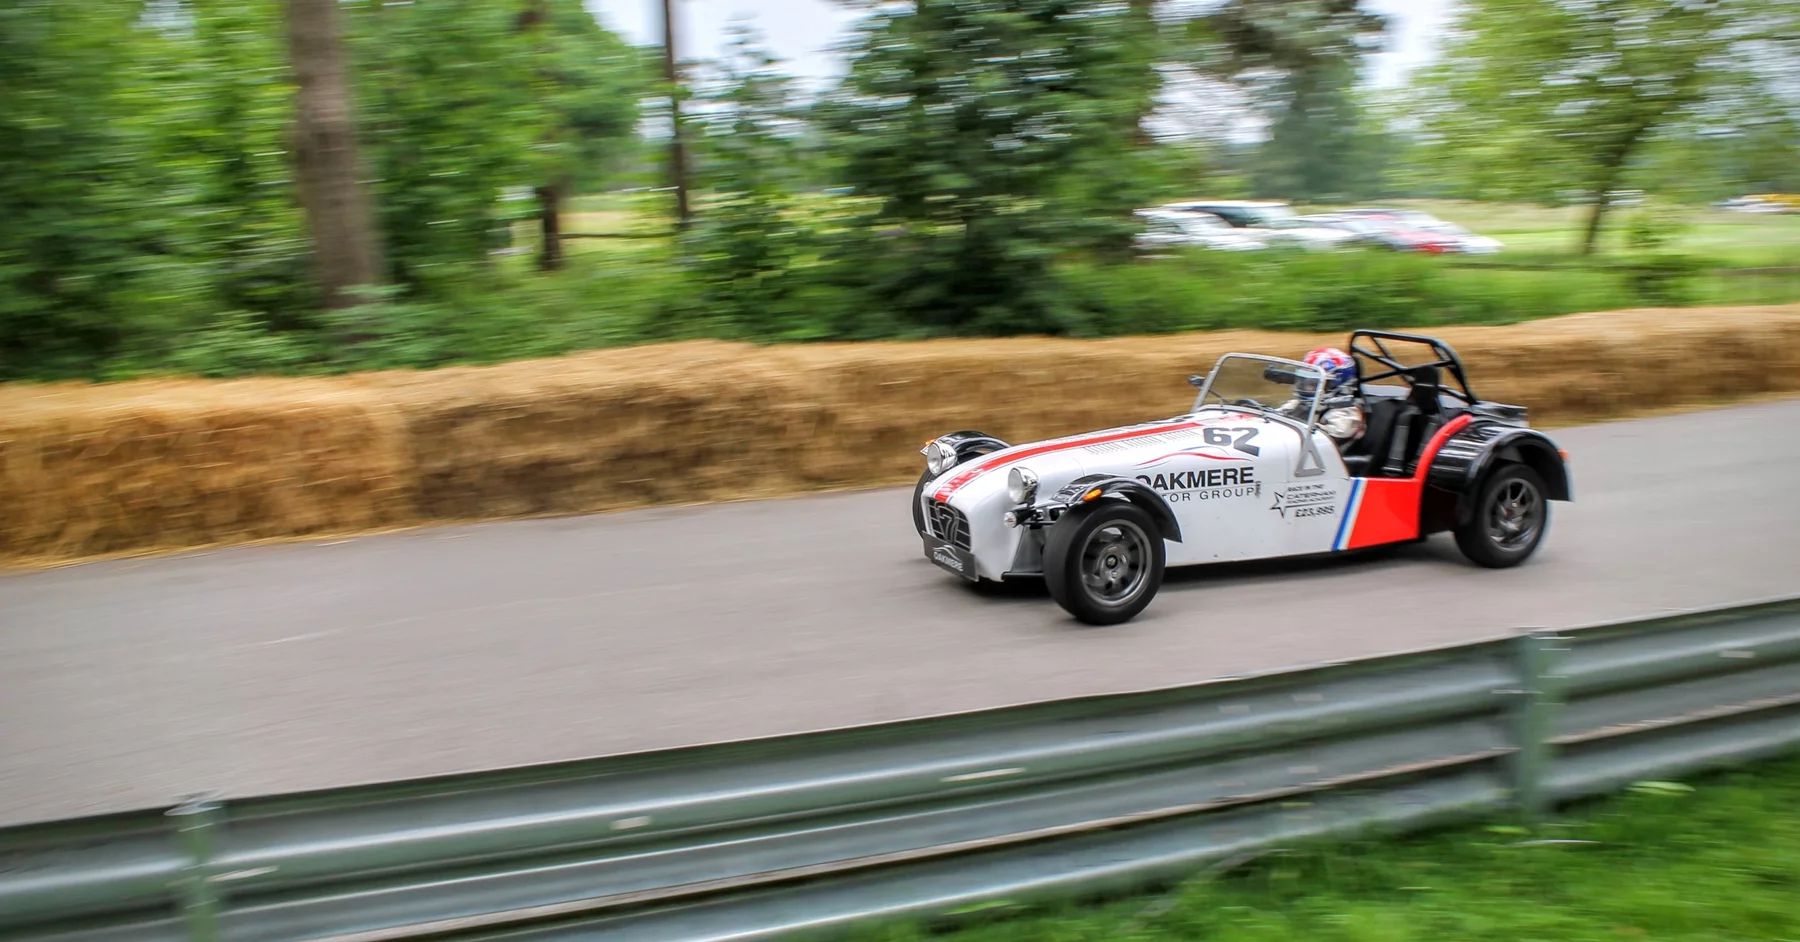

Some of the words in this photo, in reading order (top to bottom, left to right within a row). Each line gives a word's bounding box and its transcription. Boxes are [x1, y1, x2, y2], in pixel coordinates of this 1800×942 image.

[1203, 427, 1260, 457] 62
[1199, 487, 1255, 500] GROUP
[934, 552, 963, 571] OAKMERE
